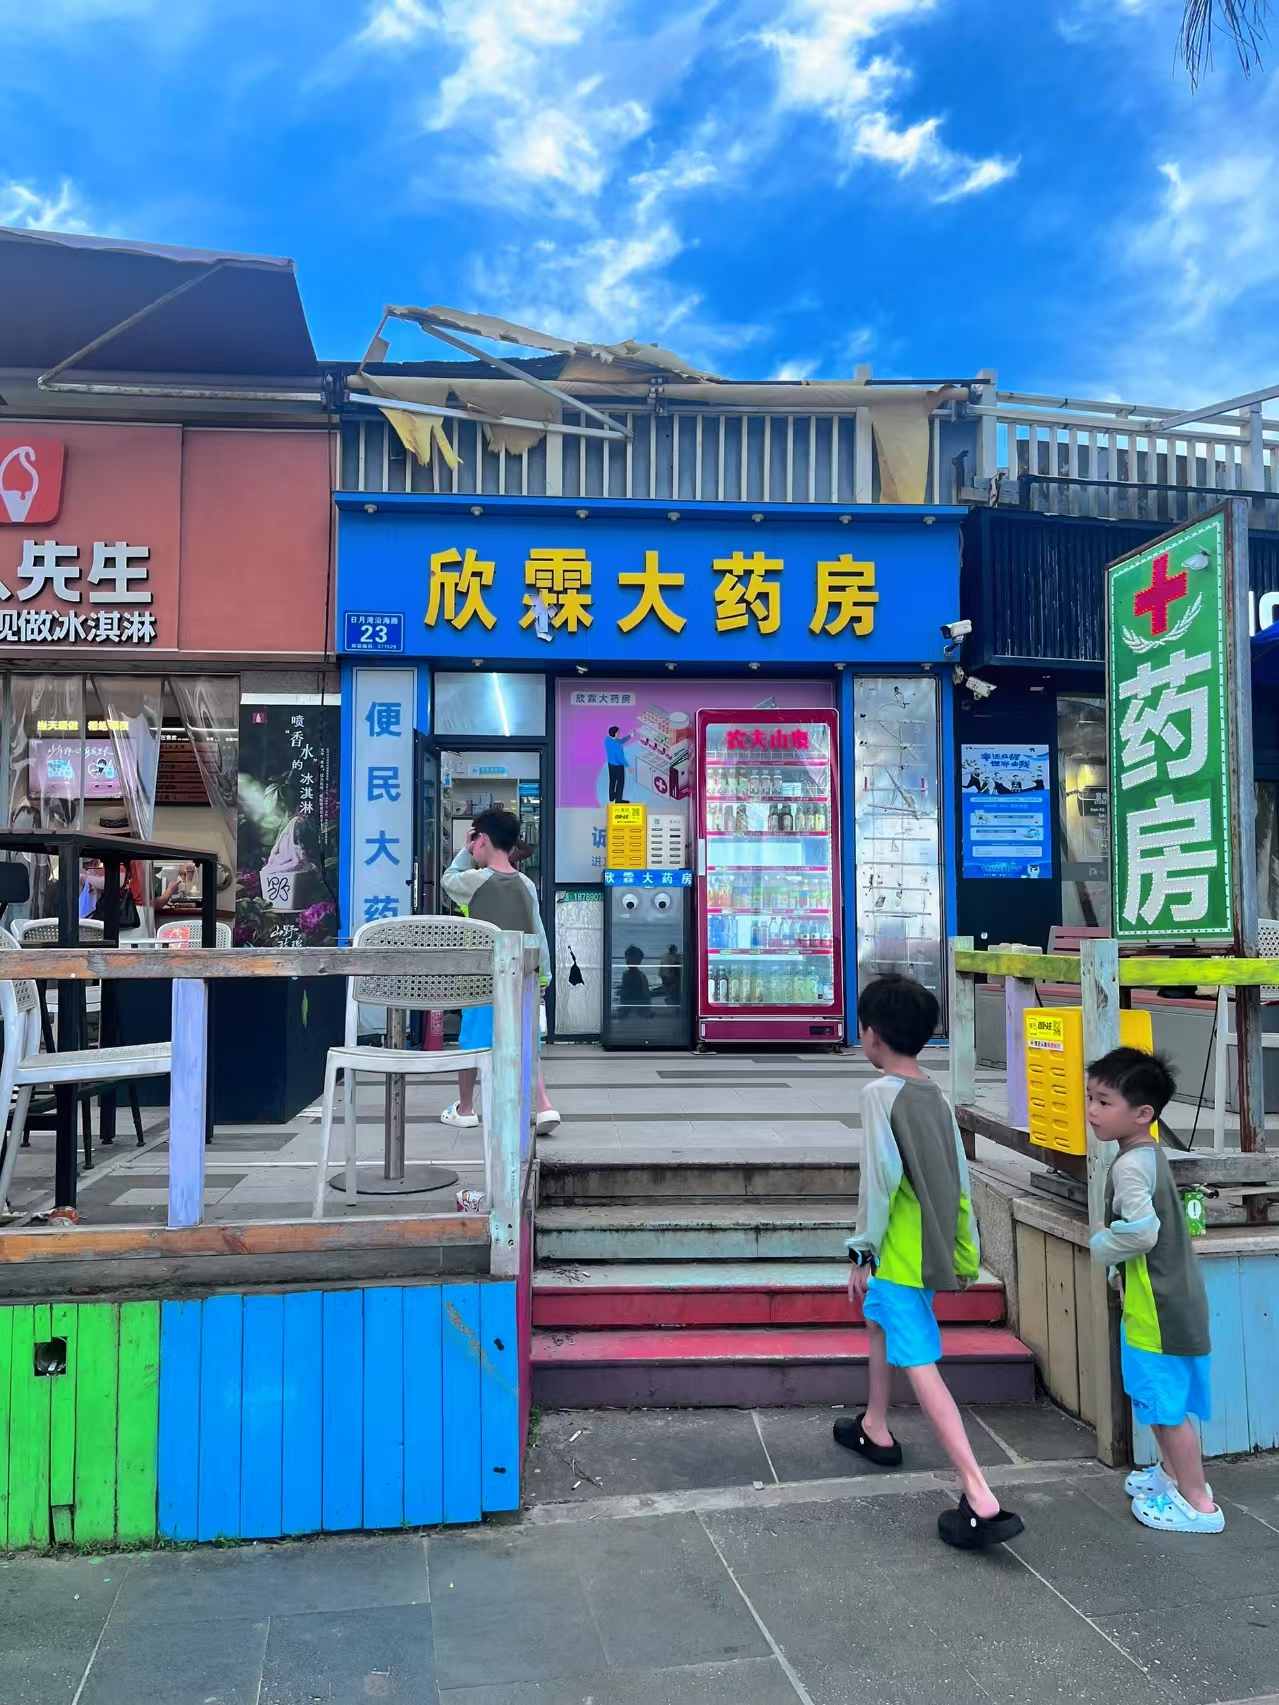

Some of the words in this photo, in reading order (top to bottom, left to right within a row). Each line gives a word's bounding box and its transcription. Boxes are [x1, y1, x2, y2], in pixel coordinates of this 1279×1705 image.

[0, 540, 152, 603] 先生
[424, 547, 879, 636] 欣霖大药房
[360, 625, 387, 643] 23
[1118, 649, 1218, 924] 药房
